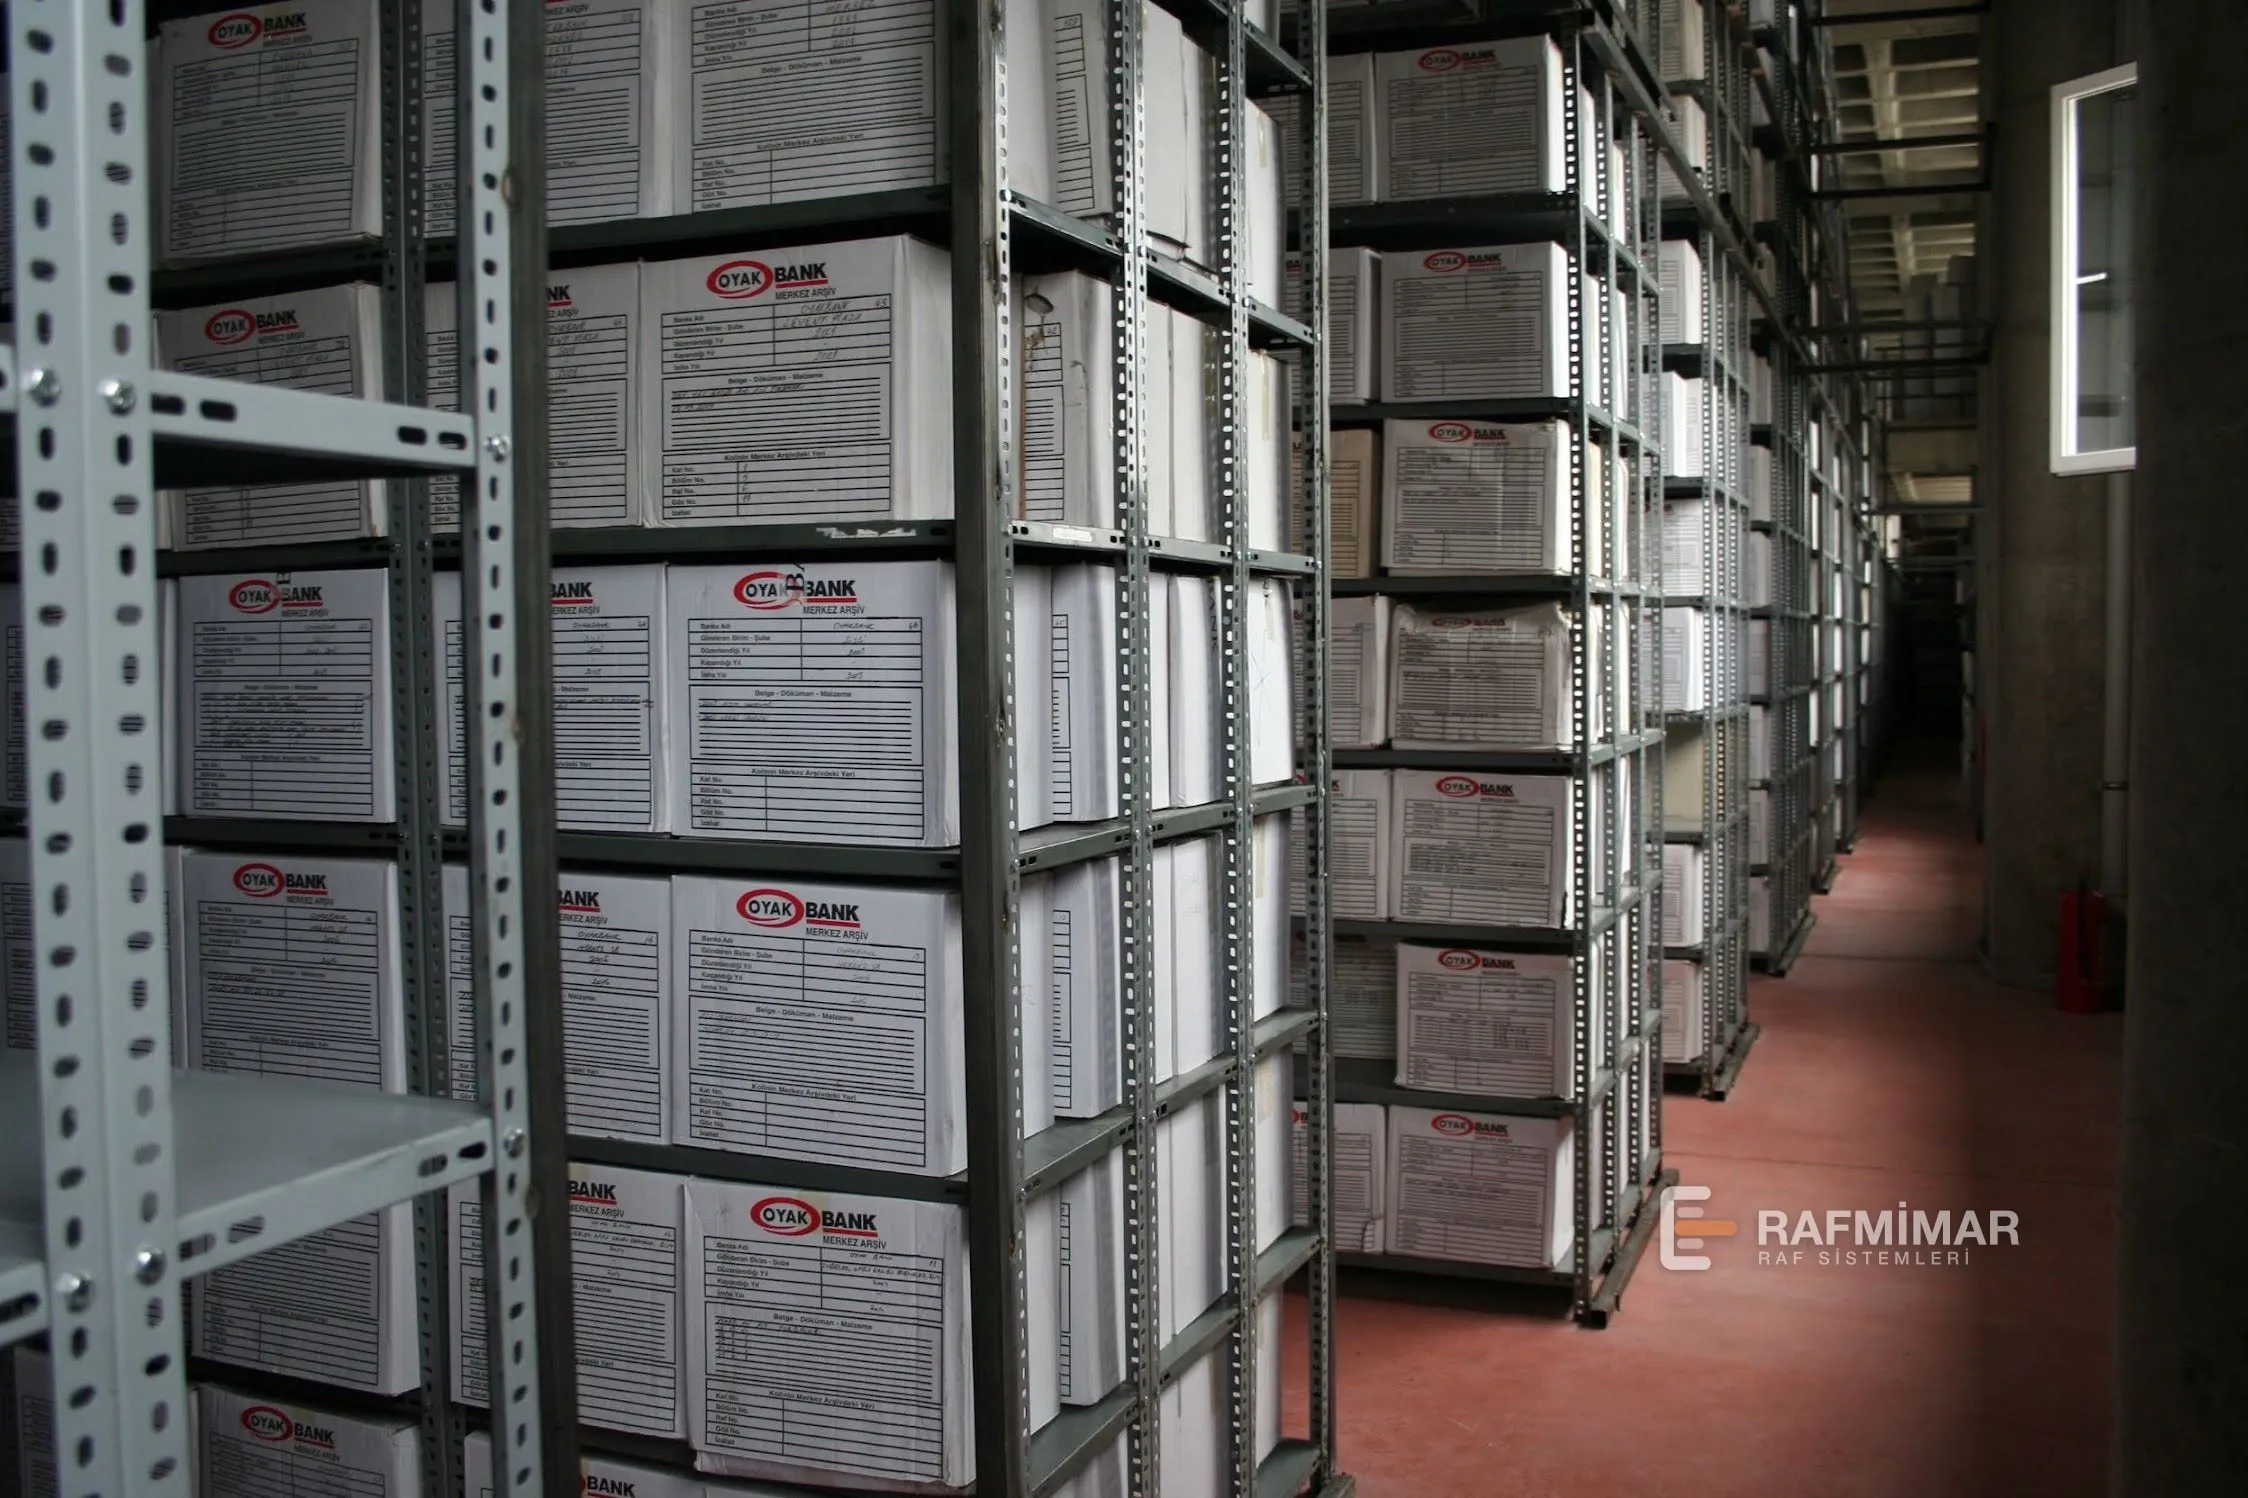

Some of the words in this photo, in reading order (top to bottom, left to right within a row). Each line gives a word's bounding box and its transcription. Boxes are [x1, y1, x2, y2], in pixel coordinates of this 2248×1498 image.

[264, 13, 306, 31] BANK
[719, 272, 761, 288] OYAK
[775, 263, 826, 282] BANK
[546, 285, 571, 301] NK
[775, 289, 810, 301] MERKEZ
[214, 319, 247, 335] OYAK
[257, 310, 298, 328] BANK
[239, 590, 271, 603] OYAK
[552, 606, 577, 615] ERKEZ
[803, 605, 838, 615] MERKEZ
[243, 873, 276, 887] OYAK
[286, 873, 328, 890] BANK
[748, 900, 792, 916] OYAK
[806, 902, 860, 921] BANK
[806, 928, 842, 938] MERKEZ
[843, 931, 869, 942] ARŞİV
[568, 1181, 616, 1200] BANK
[763, 1208, 808, 1224] OYAK
[822, 1211, 877, 1230] BANK
[823, 1236, 860, 1248] MERKEZ
[860, 1239, 887, 1251] ARŞİV
[251, 1415, 284, 1431] OYAK
[294, 1422, 335, 1444] BANK
[587, 1475, 636, 1497] BANK
